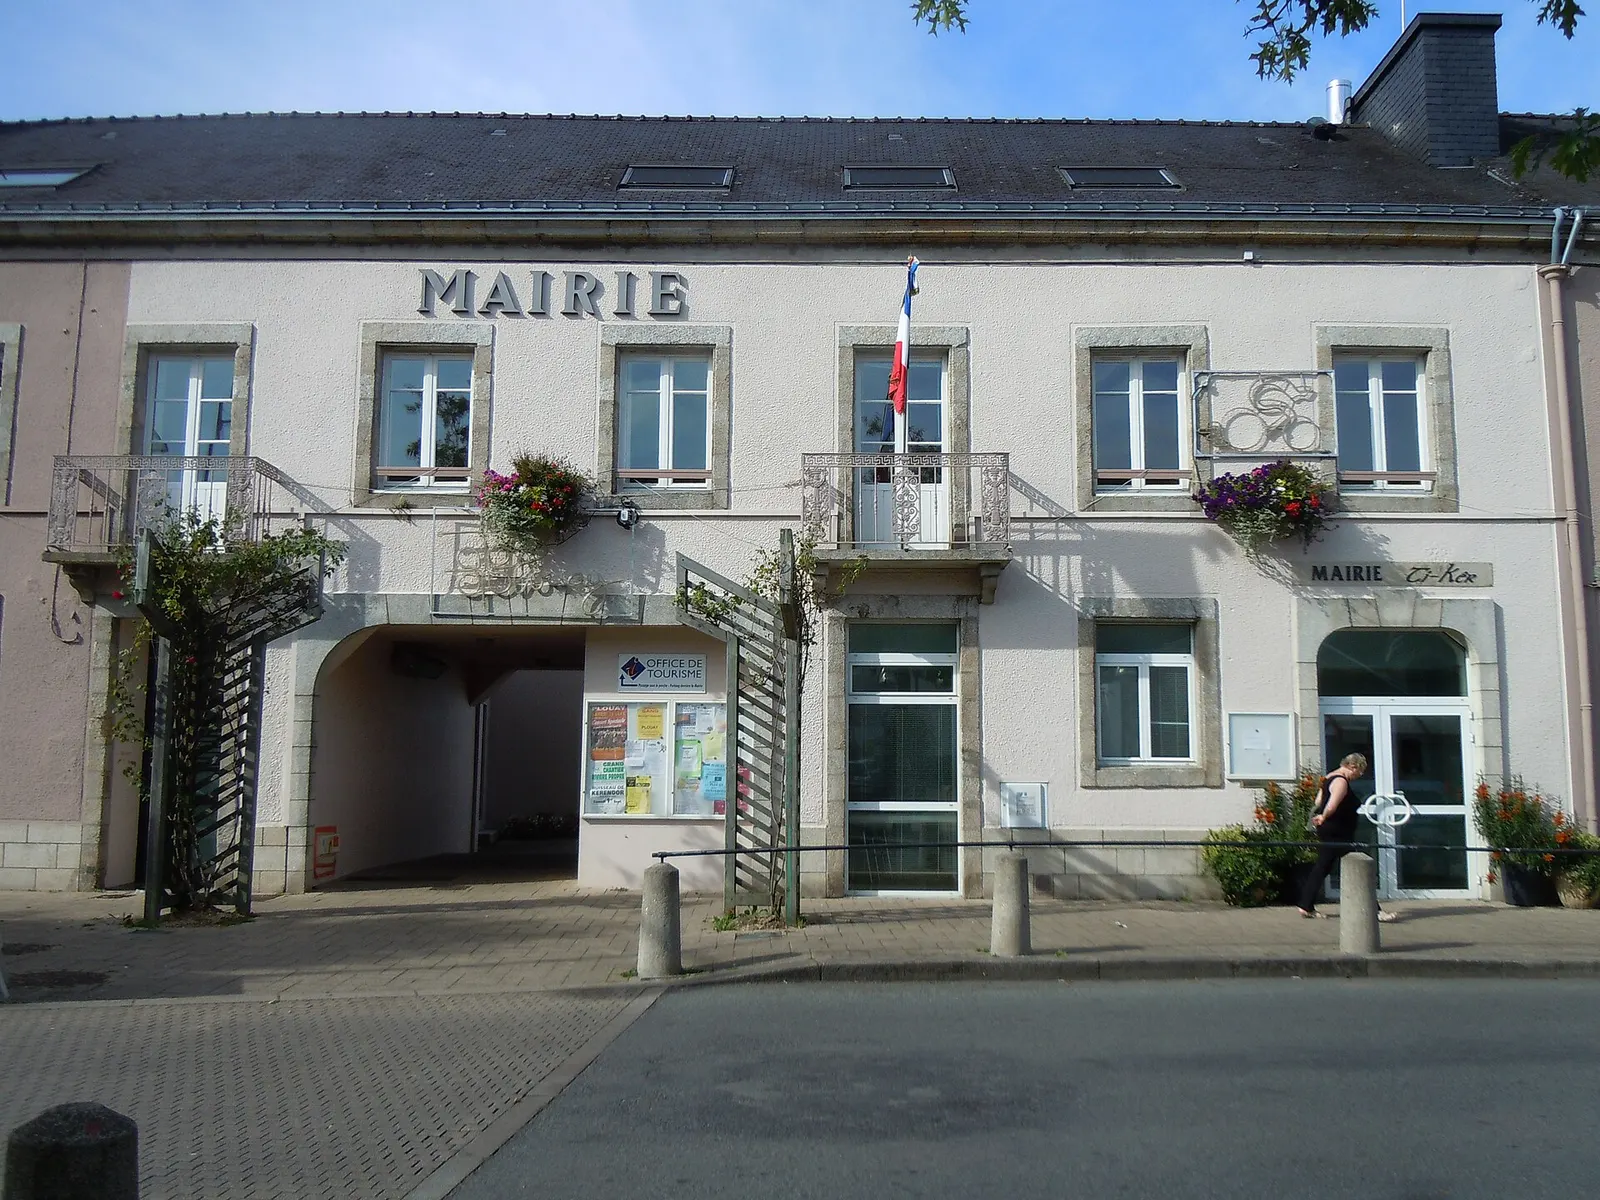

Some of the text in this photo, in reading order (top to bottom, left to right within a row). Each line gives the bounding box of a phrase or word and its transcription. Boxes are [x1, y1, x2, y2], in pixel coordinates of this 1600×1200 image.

[417, 268, 682, 315] MAIRIE
[1311, 565, 1382, 582] MAIRIE
[646, 659, 702, 668] OFFICE DE
[647, 670, 702, 679] TOURISME
